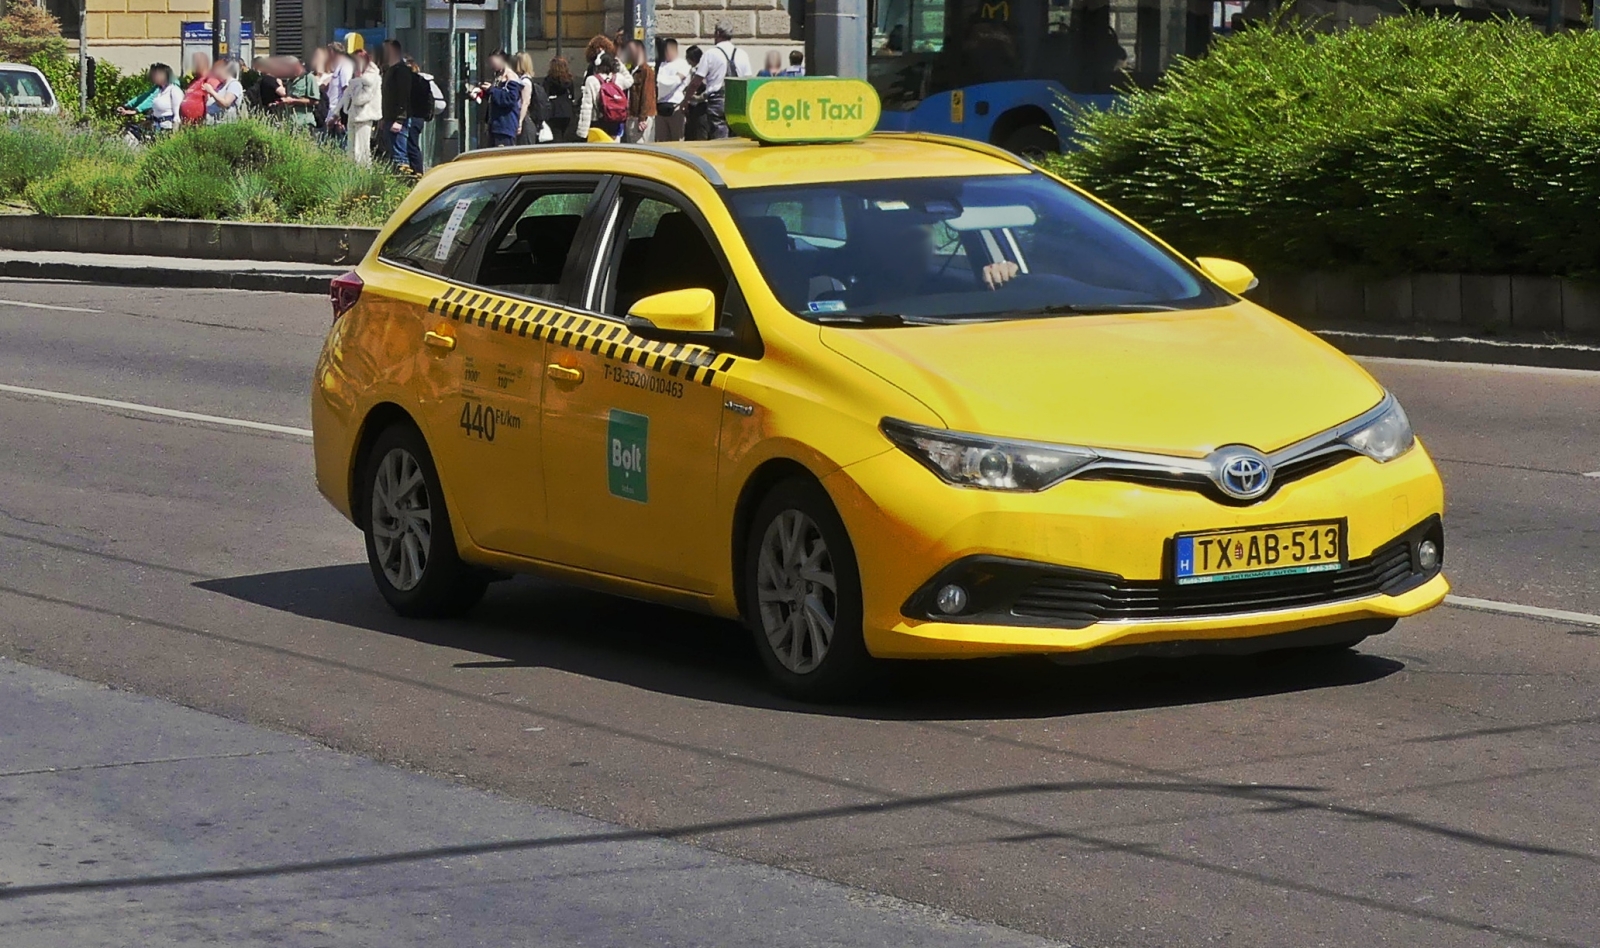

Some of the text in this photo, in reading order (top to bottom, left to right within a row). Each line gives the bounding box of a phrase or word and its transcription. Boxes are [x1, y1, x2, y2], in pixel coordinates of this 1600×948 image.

[766, 96, 863, 127] Bolt Taxi
[603, 363, 684, 399] T-13-3520/010463
[460, 401, 495, 442] 440
[612, 438, 642, 478] Bolt
[1180, 559, 1190, 571] H
[1198, 528, 1337, 571] TX AB-513
